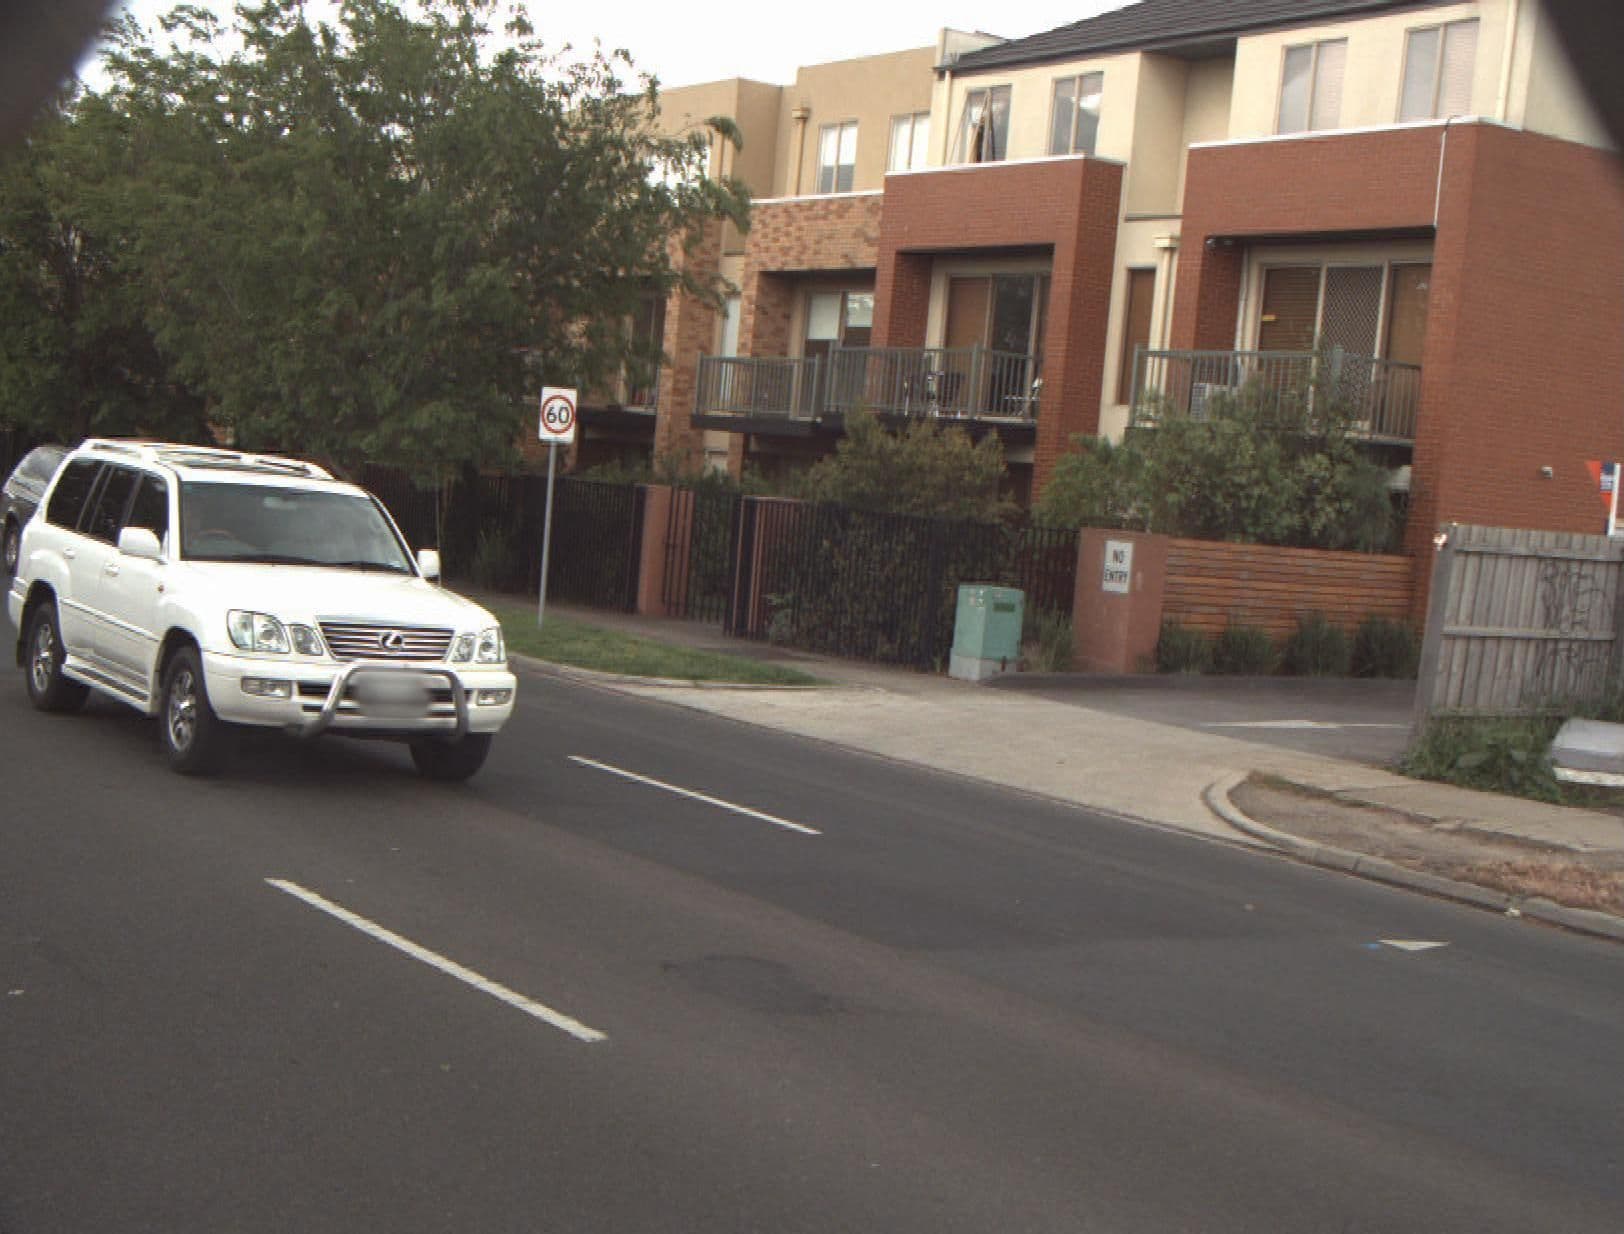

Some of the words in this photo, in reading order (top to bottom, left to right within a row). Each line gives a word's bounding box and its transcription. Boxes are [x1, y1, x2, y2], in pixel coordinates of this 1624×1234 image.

[547, 406, 570, 423] 60
[1112, 549, 1126, 563] NO
[1104, 569, 1128, 583] ENTRY
